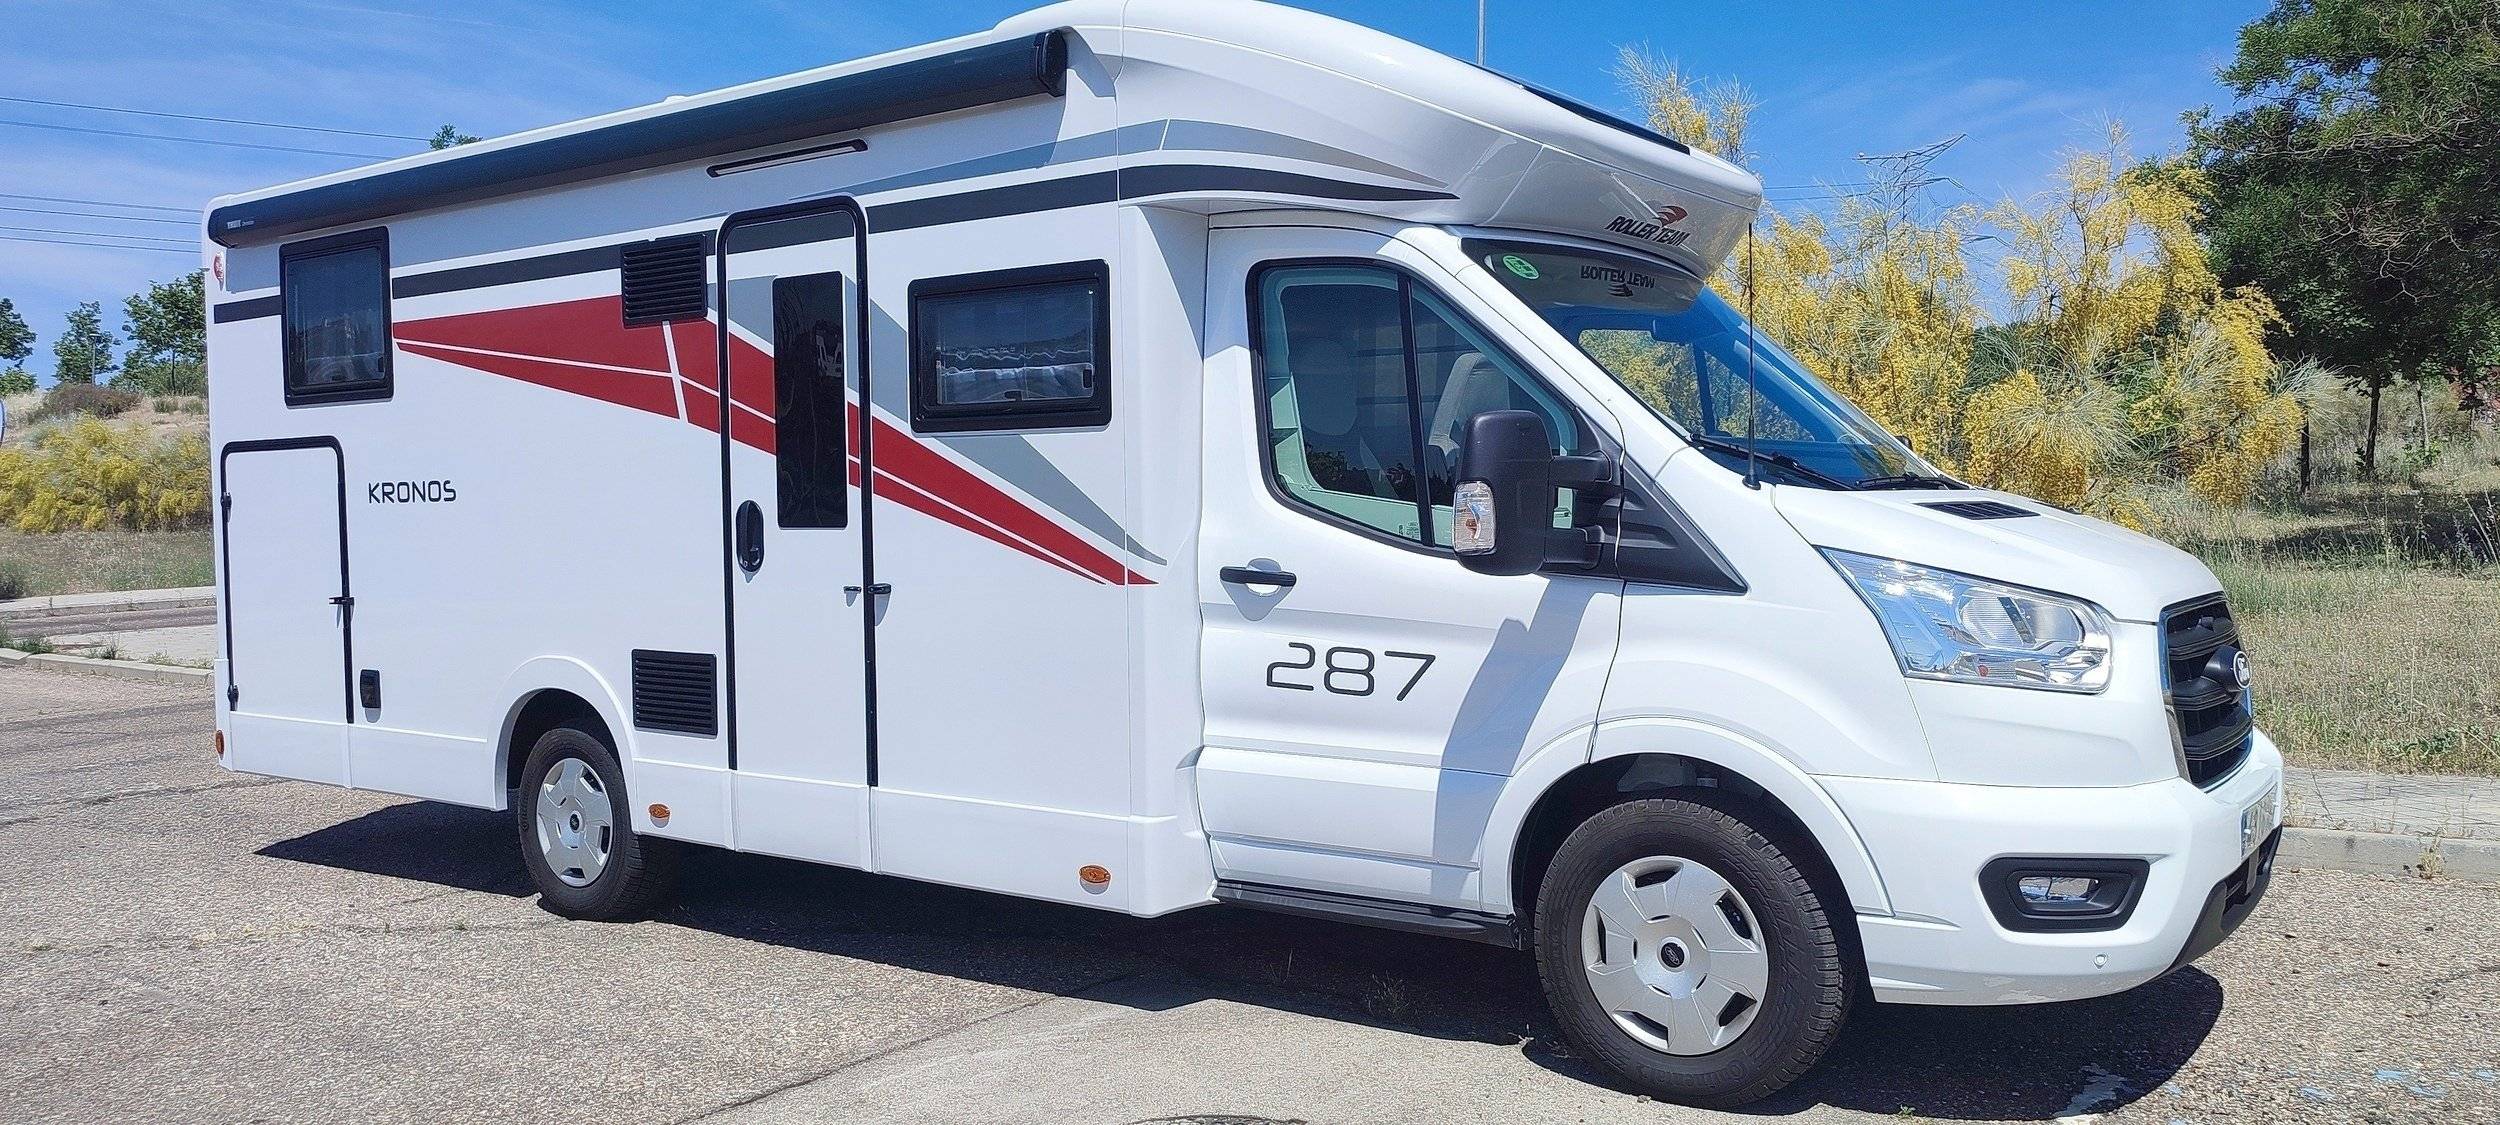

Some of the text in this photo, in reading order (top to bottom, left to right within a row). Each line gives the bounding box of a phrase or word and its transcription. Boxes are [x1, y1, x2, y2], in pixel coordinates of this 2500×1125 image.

[1604, 215, 1691, 247] ROLLER TEAM
[368, 480, 457, 504] KRONOS
[1266, 642, 1436, 701] 287
